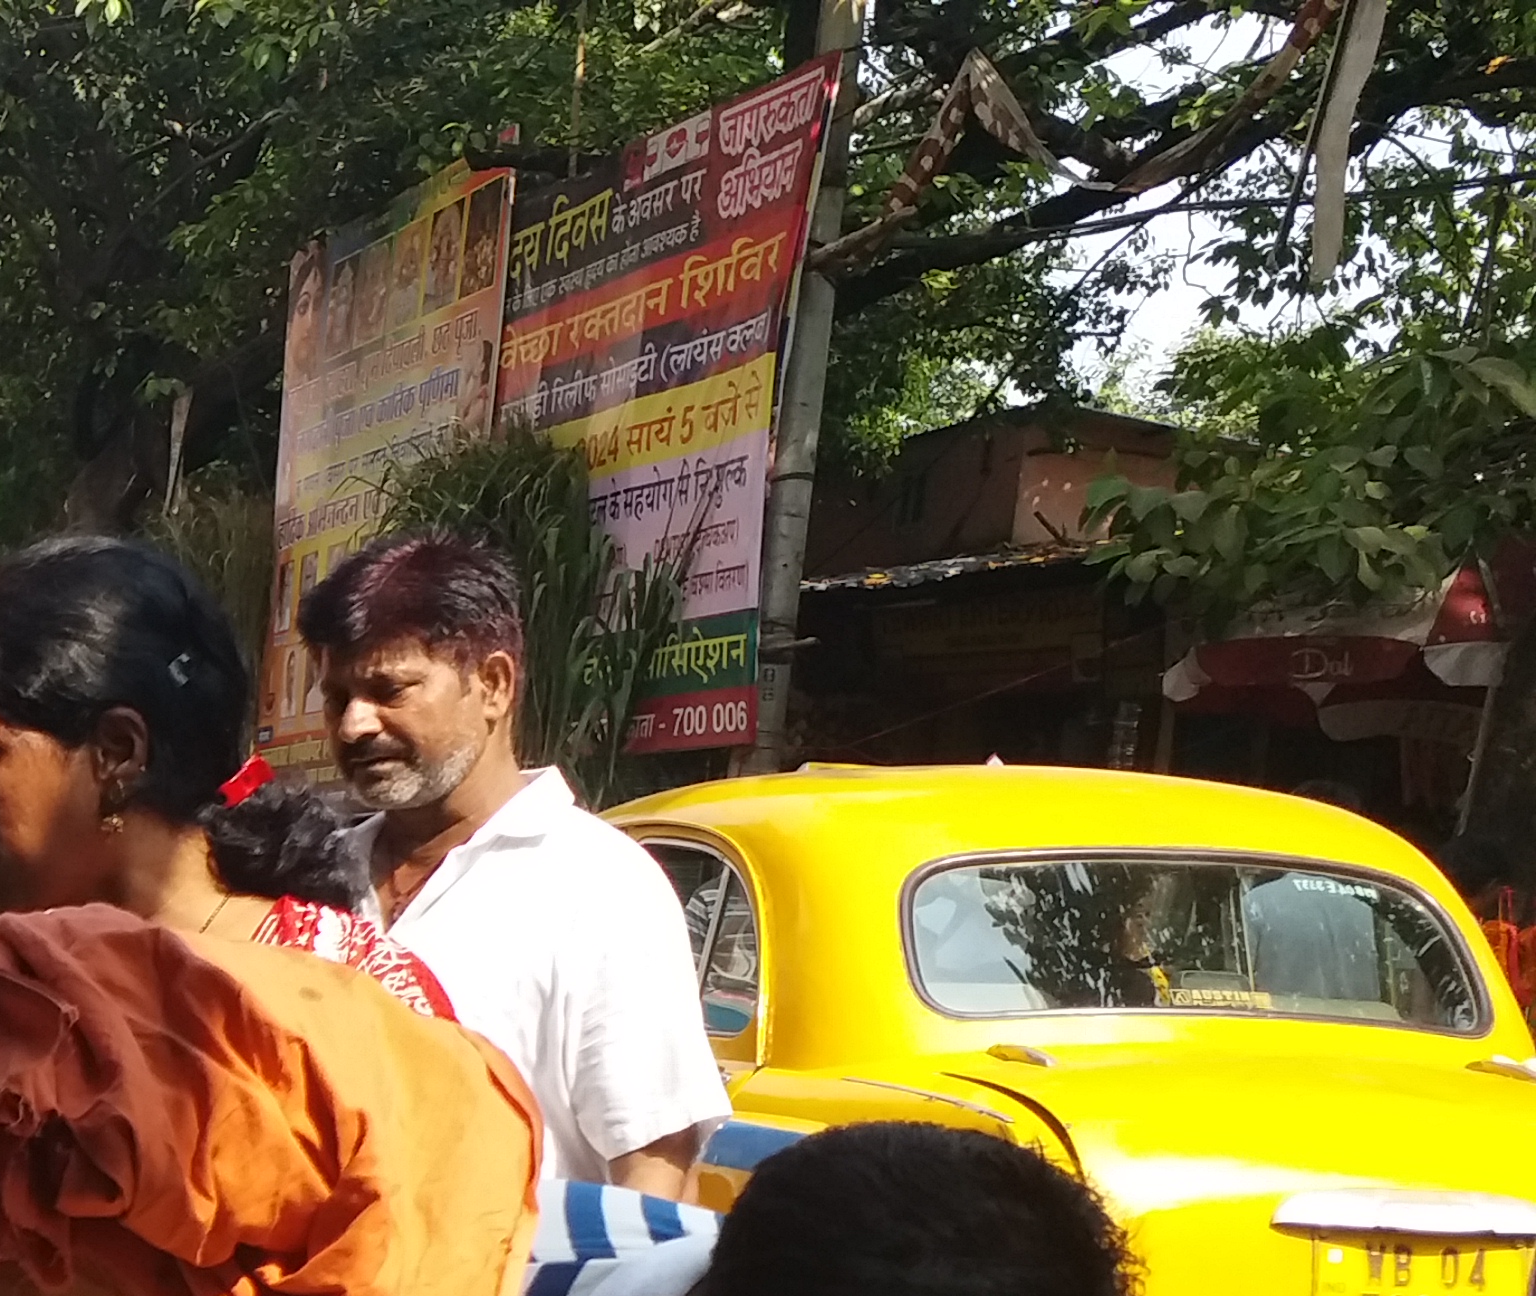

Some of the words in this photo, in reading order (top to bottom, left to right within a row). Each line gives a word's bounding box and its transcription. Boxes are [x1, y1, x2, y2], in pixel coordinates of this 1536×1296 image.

[546, 188, 613, 268] दिवस
[611, 193, 628, 234] के
[627, 179, 679, 228] अवसर
[681, 167, 707, 204] पर
[717, 138, 803, 220] अभियान
[569, 278, 674, 351] रक्तदान
[679, 231, 787, 309] शिविर
[626, 406, 676, 456] सायं
[680, 404, 695, 445] 5
[702, 380, 739, 433] बजे
[744, 370, 763, 420] से
[622, 465, 676, 521] सहयोग
[672, 704, 707, 737] 700
[712, 700, 748, 734] 006
[1366, 1243, 1412, 1288] WB
[1440, 1246, 1486, 1291] 04
